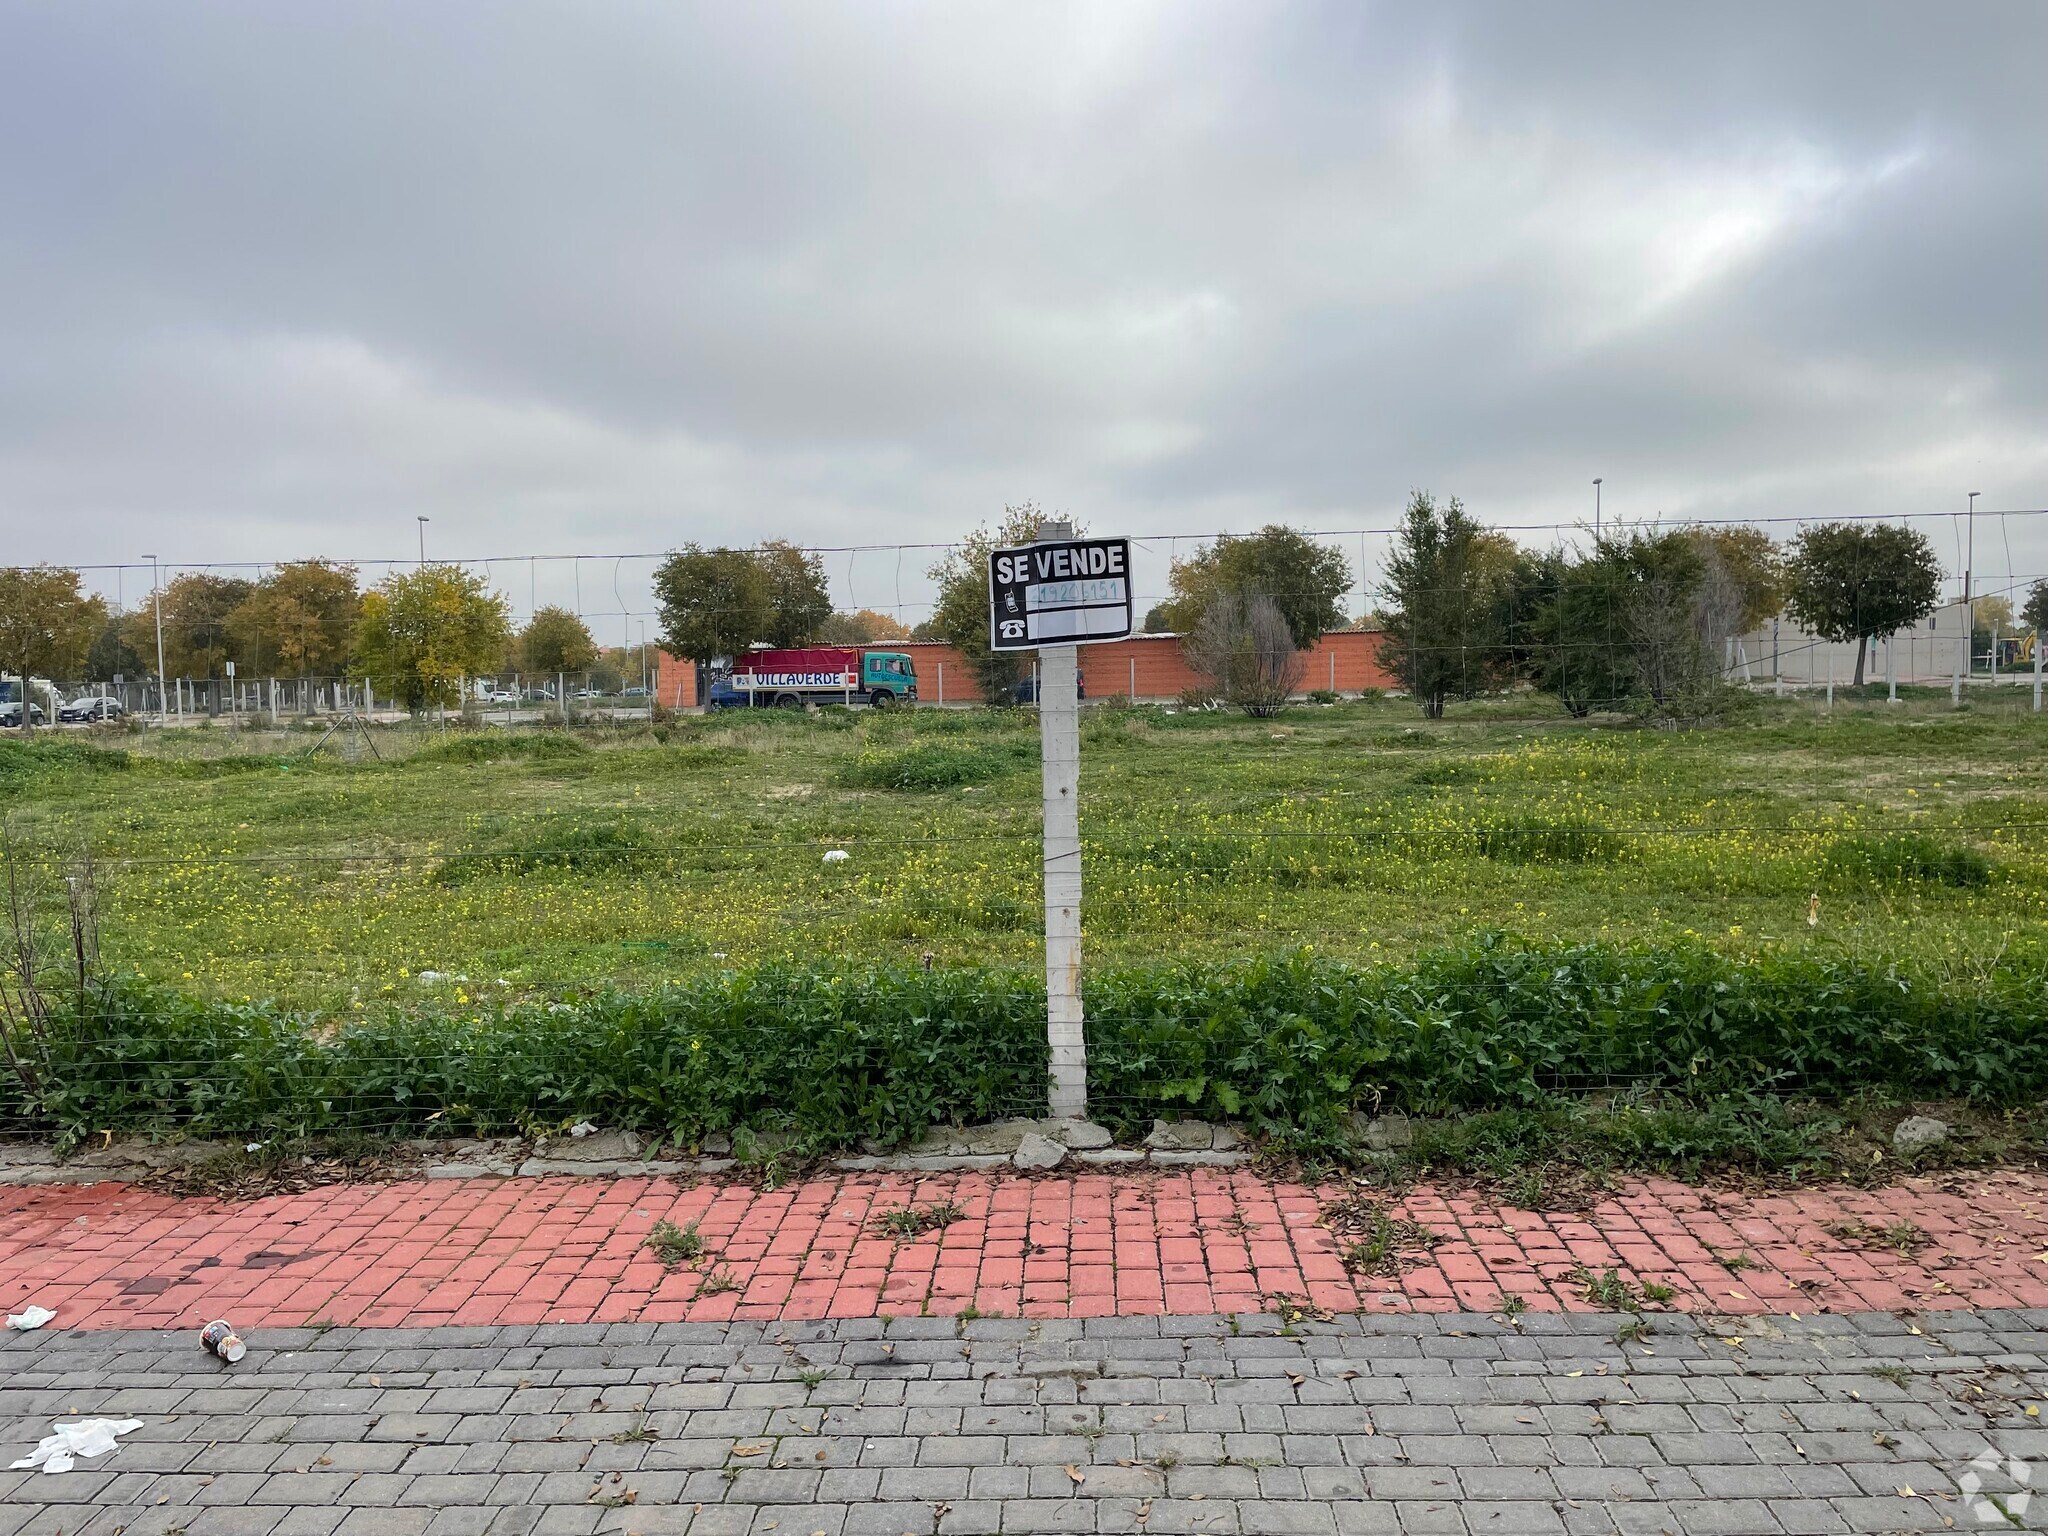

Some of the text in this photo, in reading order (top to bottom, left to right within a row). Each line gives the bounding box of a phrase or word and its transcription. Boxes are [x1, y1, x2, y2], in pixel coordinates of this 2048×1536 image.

[997, 545, 1124, 584] SE VENDE
[756, 672, 841, 686] VILLAVERDE
